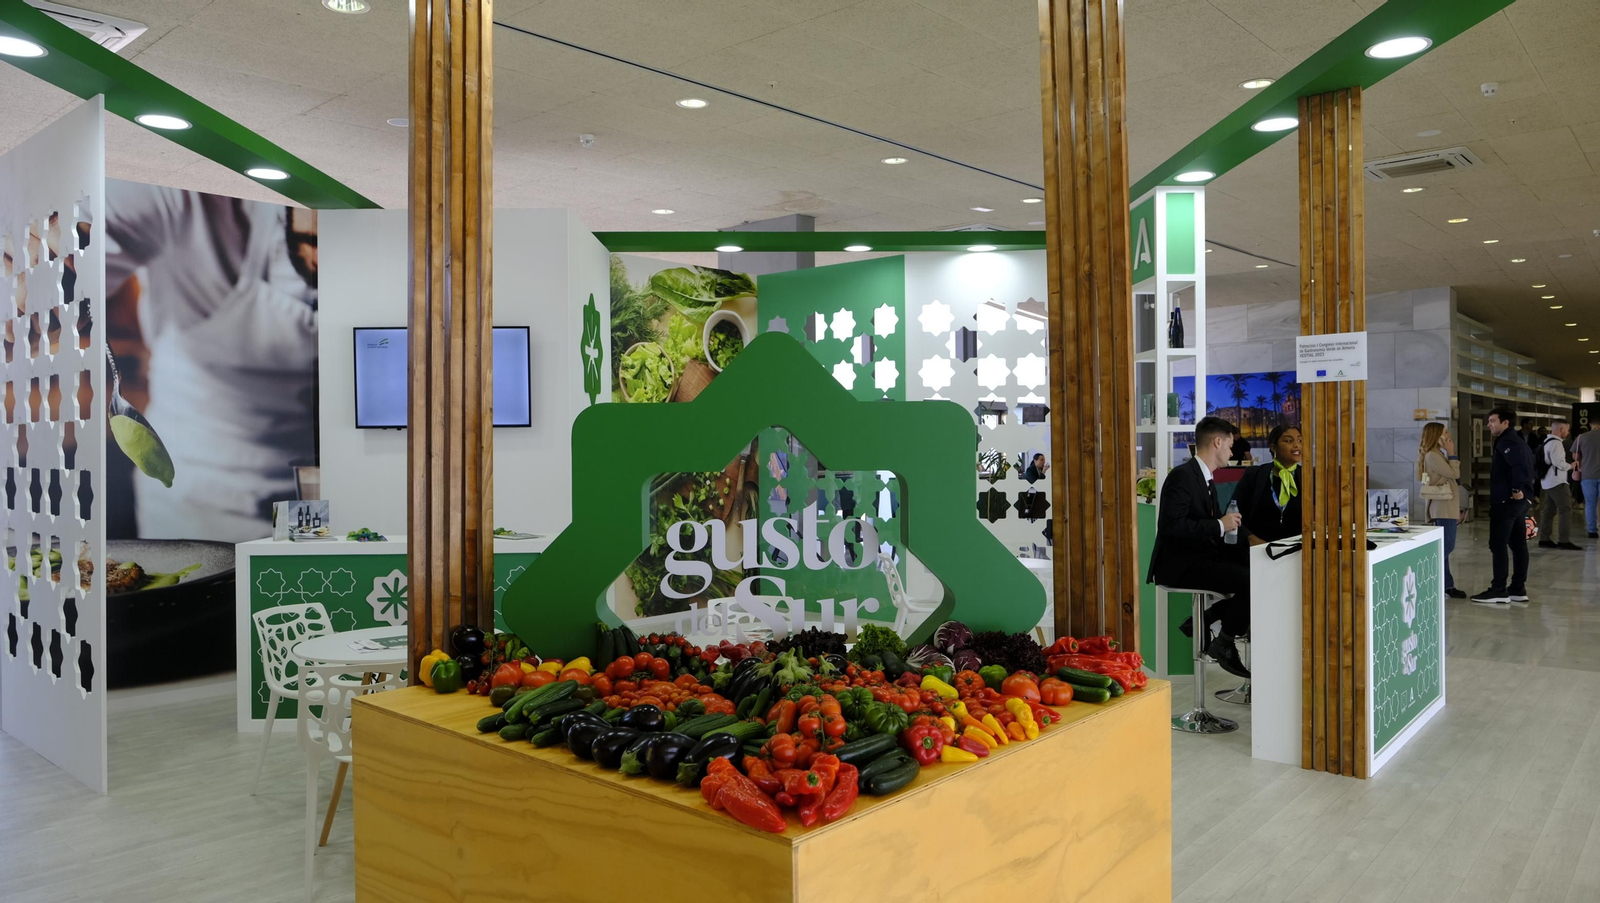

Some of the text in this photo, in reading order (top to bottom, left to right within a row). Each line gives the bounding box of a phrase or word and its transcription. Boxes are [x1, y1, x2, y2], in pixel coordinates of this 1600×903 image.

[1580, 409, 1588, 429] OS
[660, 500, 879, 599] gusto
[674, 575, 881, 646] del Sur
